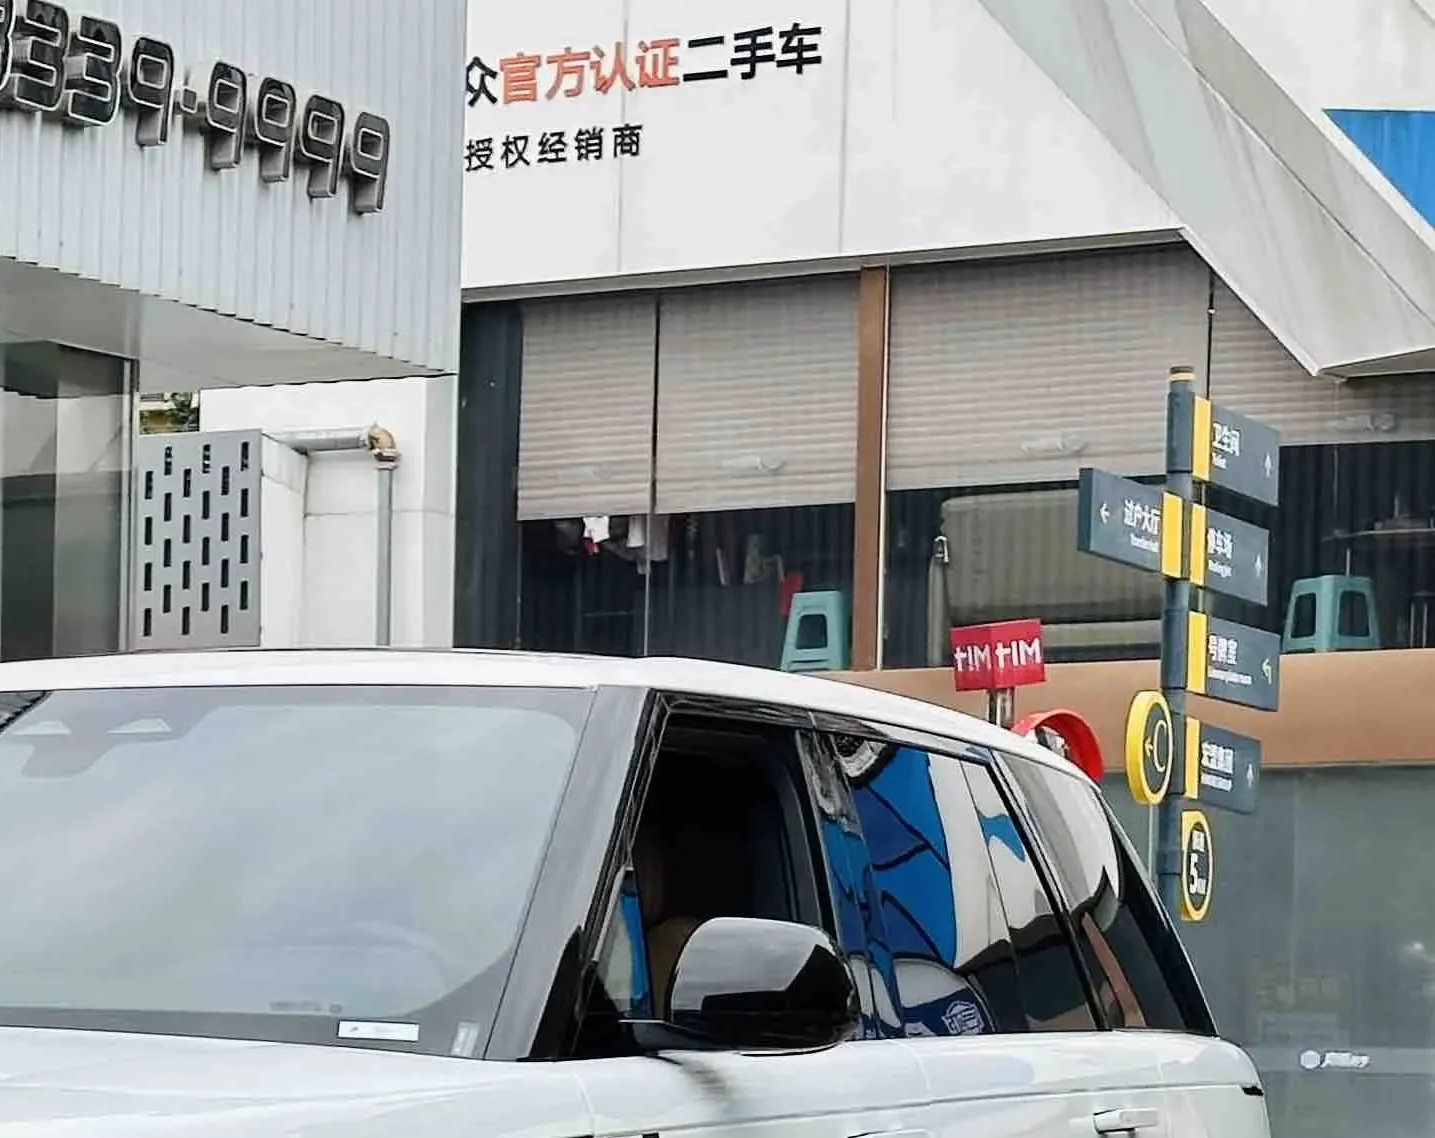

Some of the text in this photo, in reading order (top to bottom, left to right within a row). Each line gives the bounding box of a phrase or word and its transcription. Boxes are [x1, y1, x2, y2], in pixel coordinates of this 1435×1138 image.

[465, 123, 643, 172] 授权经销商
